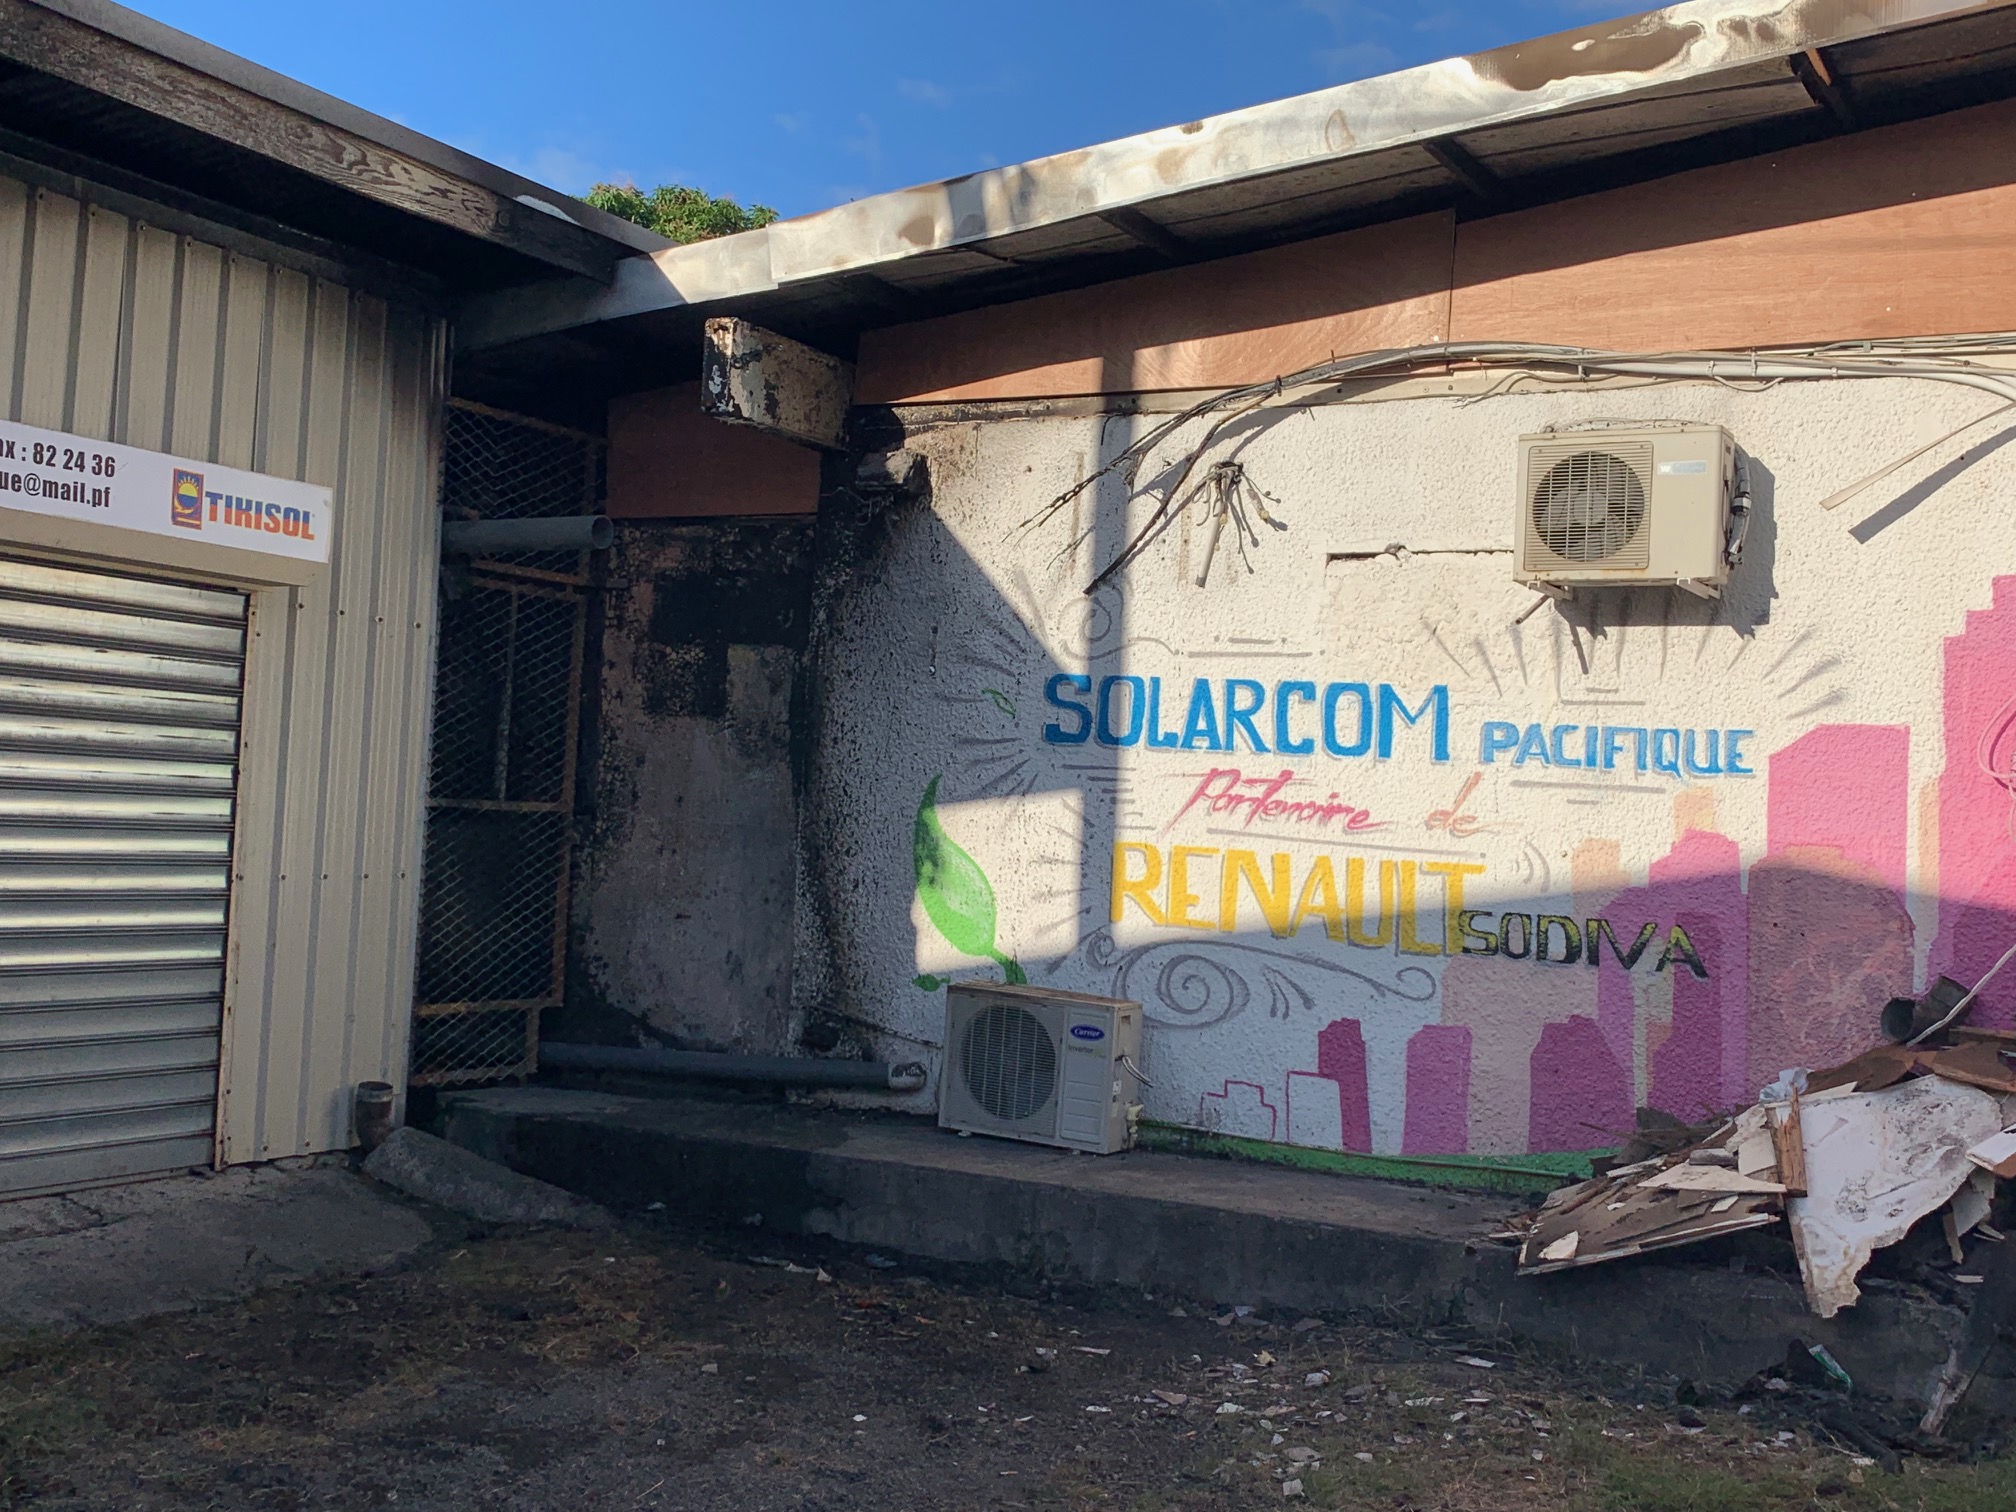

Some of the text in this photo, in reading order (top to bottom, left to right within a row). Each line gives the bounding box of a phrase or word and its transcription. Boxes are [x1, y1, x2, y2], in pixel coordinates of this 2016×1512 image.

[33, 442, 57, 468] 82
[63, 448, 85, 473] 24
[92, 453, 116, 478] 36
[205, 491, 315, 541] TIKISOL
[1044, 672, 1754, 779] SOLARCOM PACIFIQUE
[1426, 770, 1505, 835] de
[1110, 841, 1710, 979] RENAULT SODIVA
[1074, 1027, 1101, 1037] Carrier
